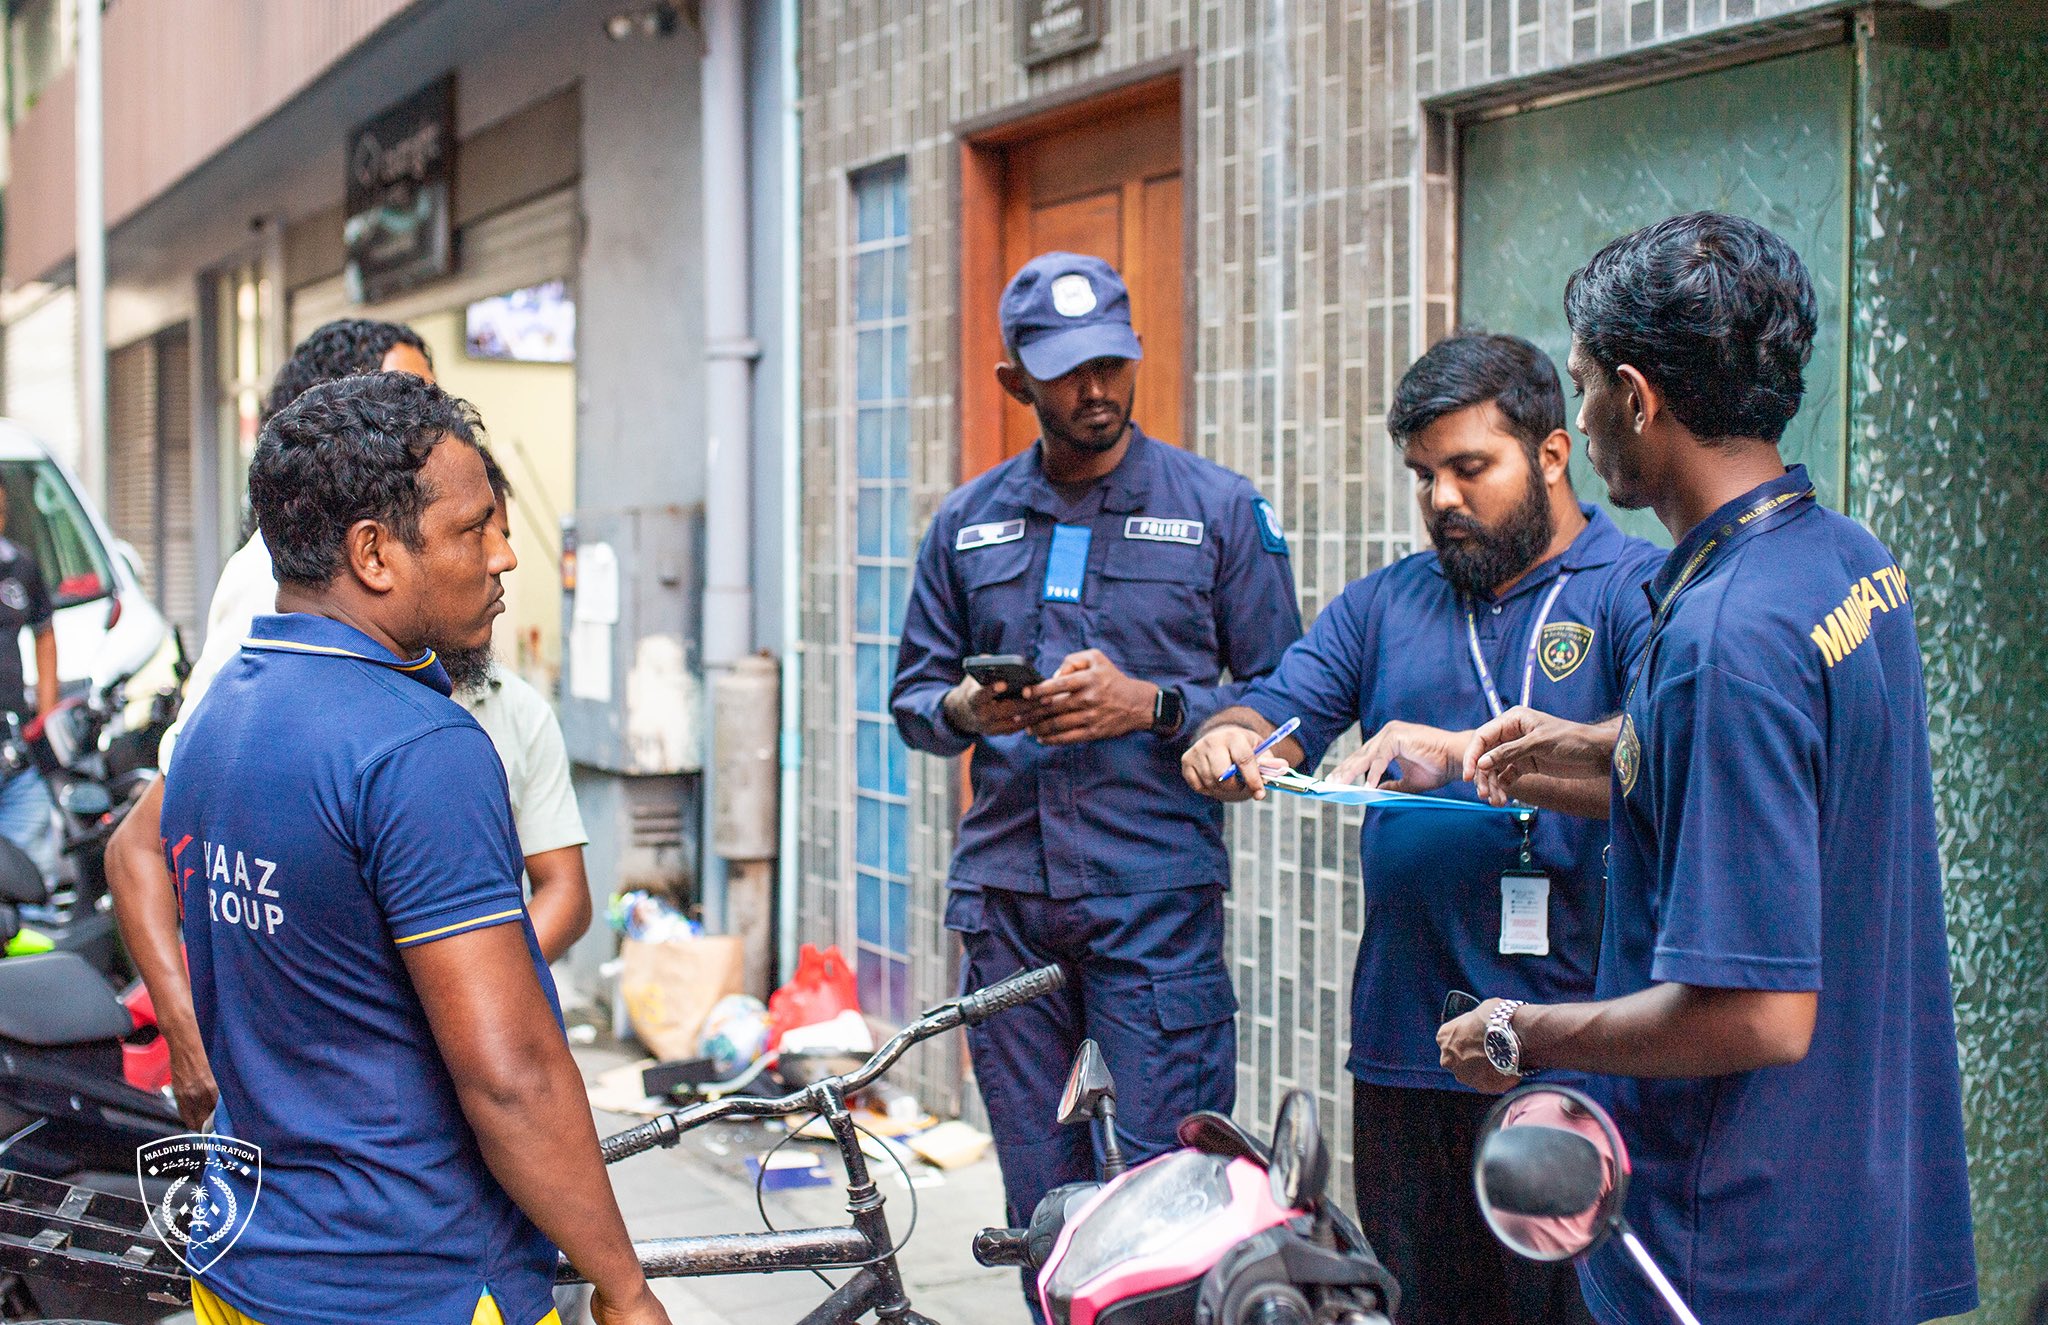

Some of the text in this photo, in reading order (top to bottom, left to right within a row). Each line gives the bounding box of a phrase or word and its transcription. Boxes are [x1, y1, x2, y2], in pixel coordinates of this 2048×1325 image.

[1738, 499, 1778, 525] MALDIVES
[1139, 521, 1189, 538] POLICE
[208, 887, 284, 935] ROUP
